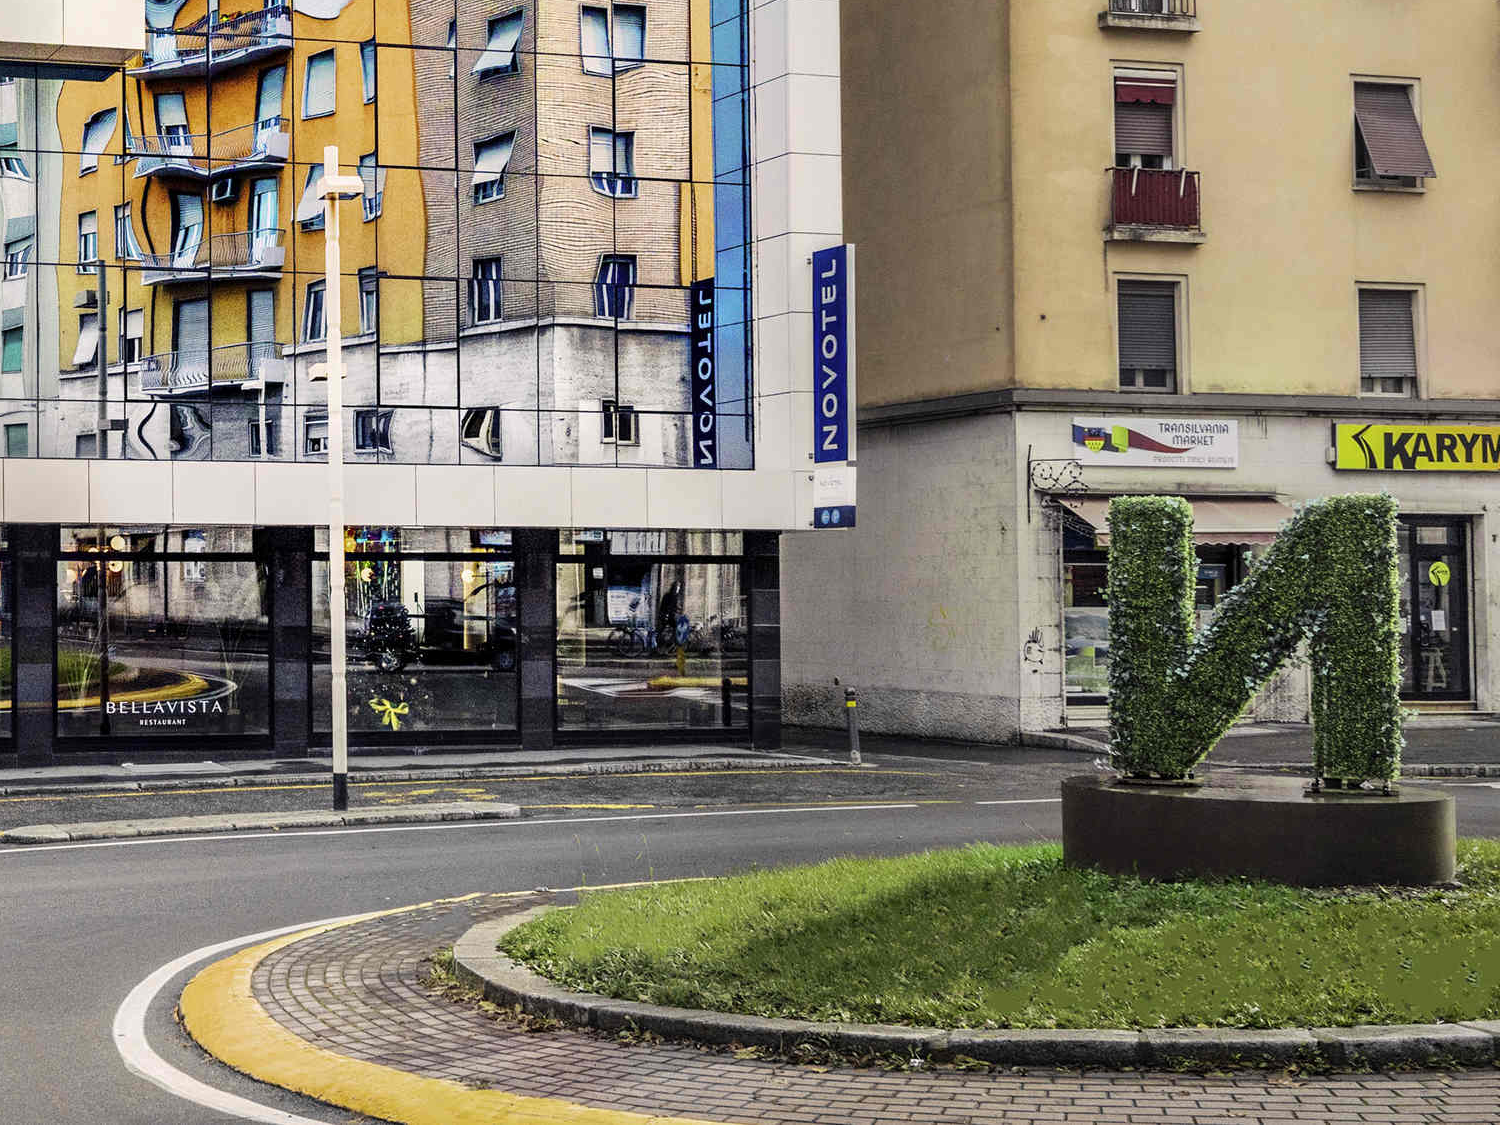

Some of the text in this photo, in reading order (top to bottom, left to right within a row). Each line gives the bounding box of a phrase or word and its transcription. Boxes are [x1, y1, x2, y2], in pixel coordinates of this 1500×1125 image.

[821, 258, 839, 452] NOVOTEL
[1158, 422, 1229, 435] TRANSILVANIA
[1172, 435, 1214, 446] MARKET
[105, 700, 223, 714] BELLAVISTA
[139, 718, 187, 726] RESTAURANT
